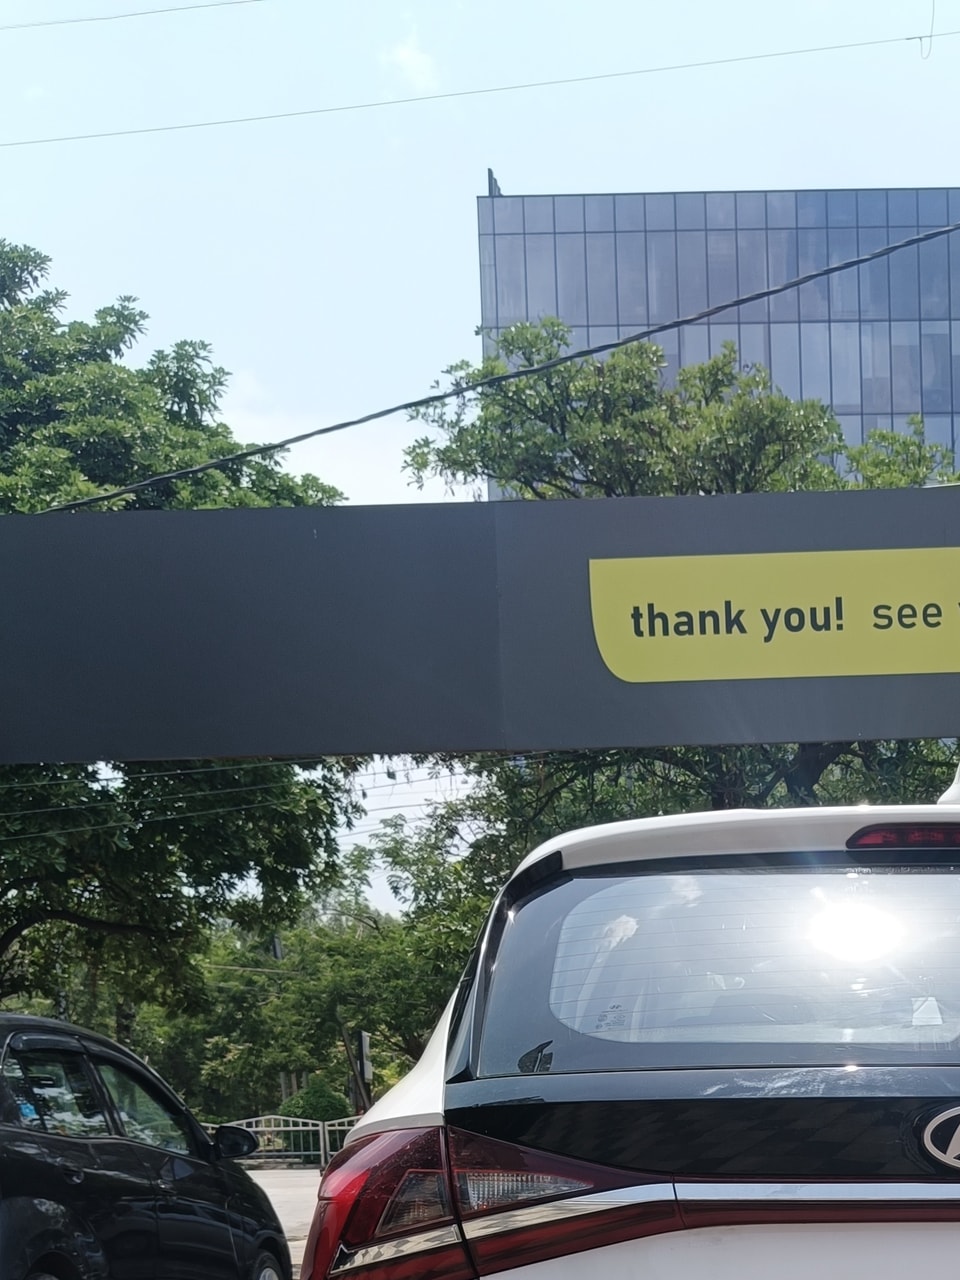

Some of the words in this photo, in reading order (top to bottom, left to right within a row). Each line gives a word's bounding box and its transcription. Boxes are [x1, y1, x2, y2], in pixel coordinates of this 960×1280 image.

[630, 599, 748, 638] thank
[759, 596, 844, 643] you!
[872, 602, 943, 630] see
